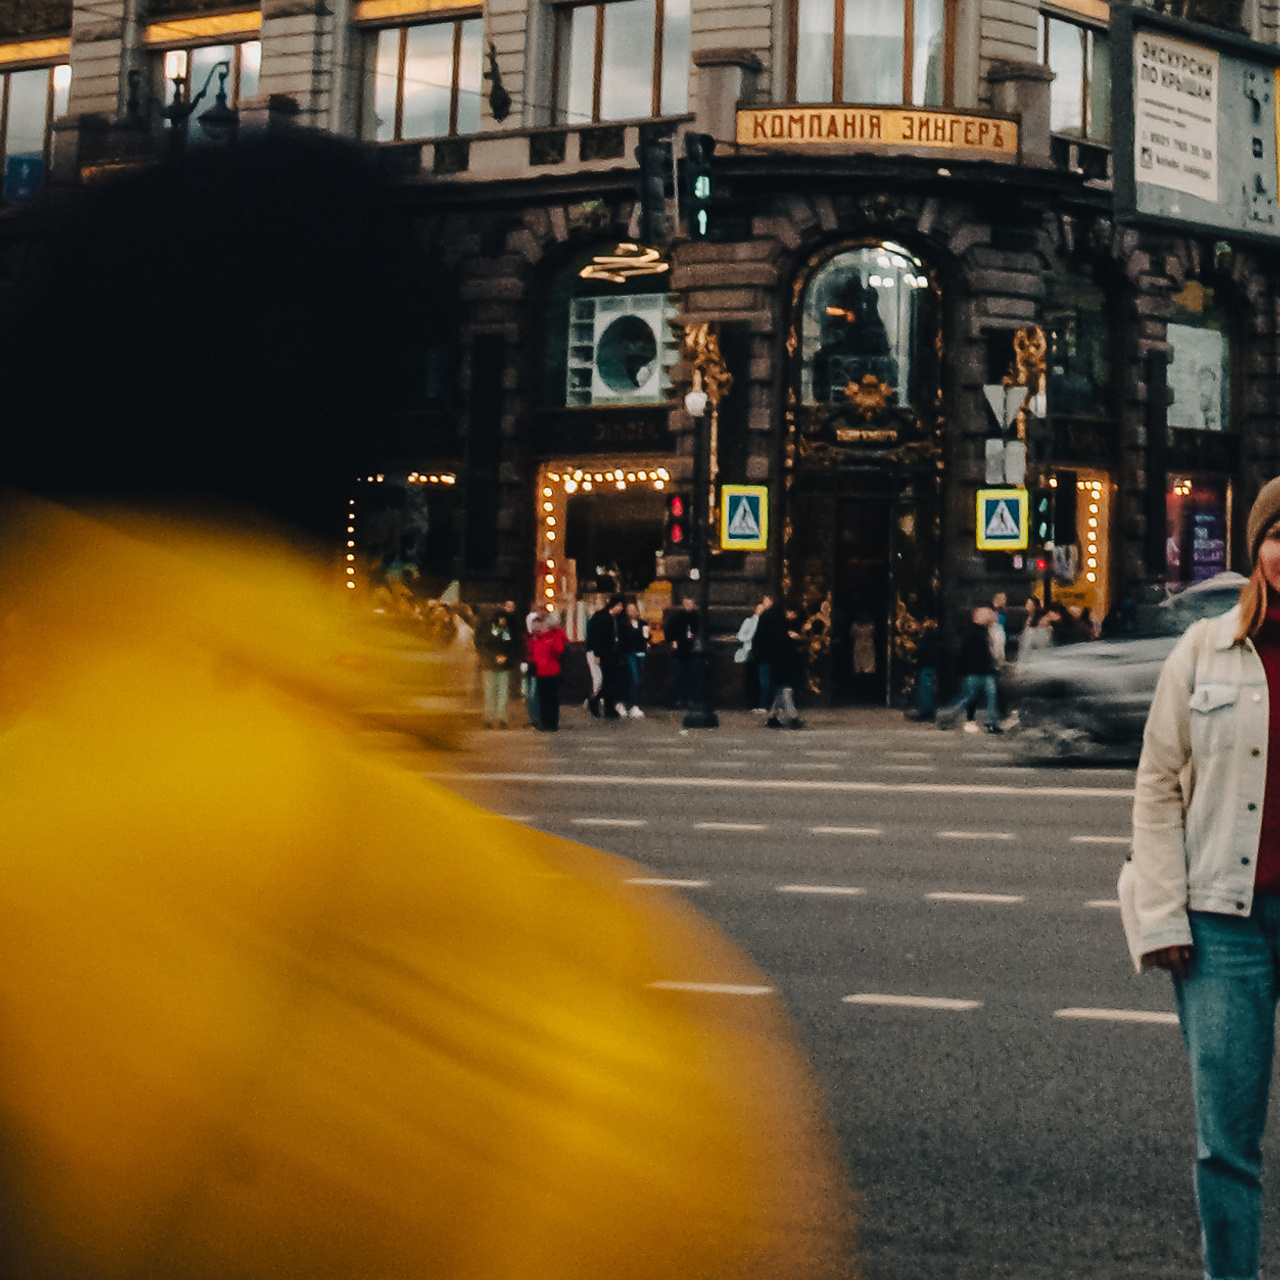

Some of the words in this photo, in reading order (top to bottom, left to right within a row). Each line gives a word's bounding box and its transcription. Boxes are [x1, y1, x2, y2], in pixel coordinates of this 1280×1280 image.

[1142, 41, 1212, 81] ЭКСКУРСИИ
[1141, 63, 1158, 83] ПО
[1162, 70, 1212, 102] КРЫШАМ
[753, 114, 881, 139] КОМПАНІЯ
[902, 116, 1004, 147] ЗИНГЕРЪ
